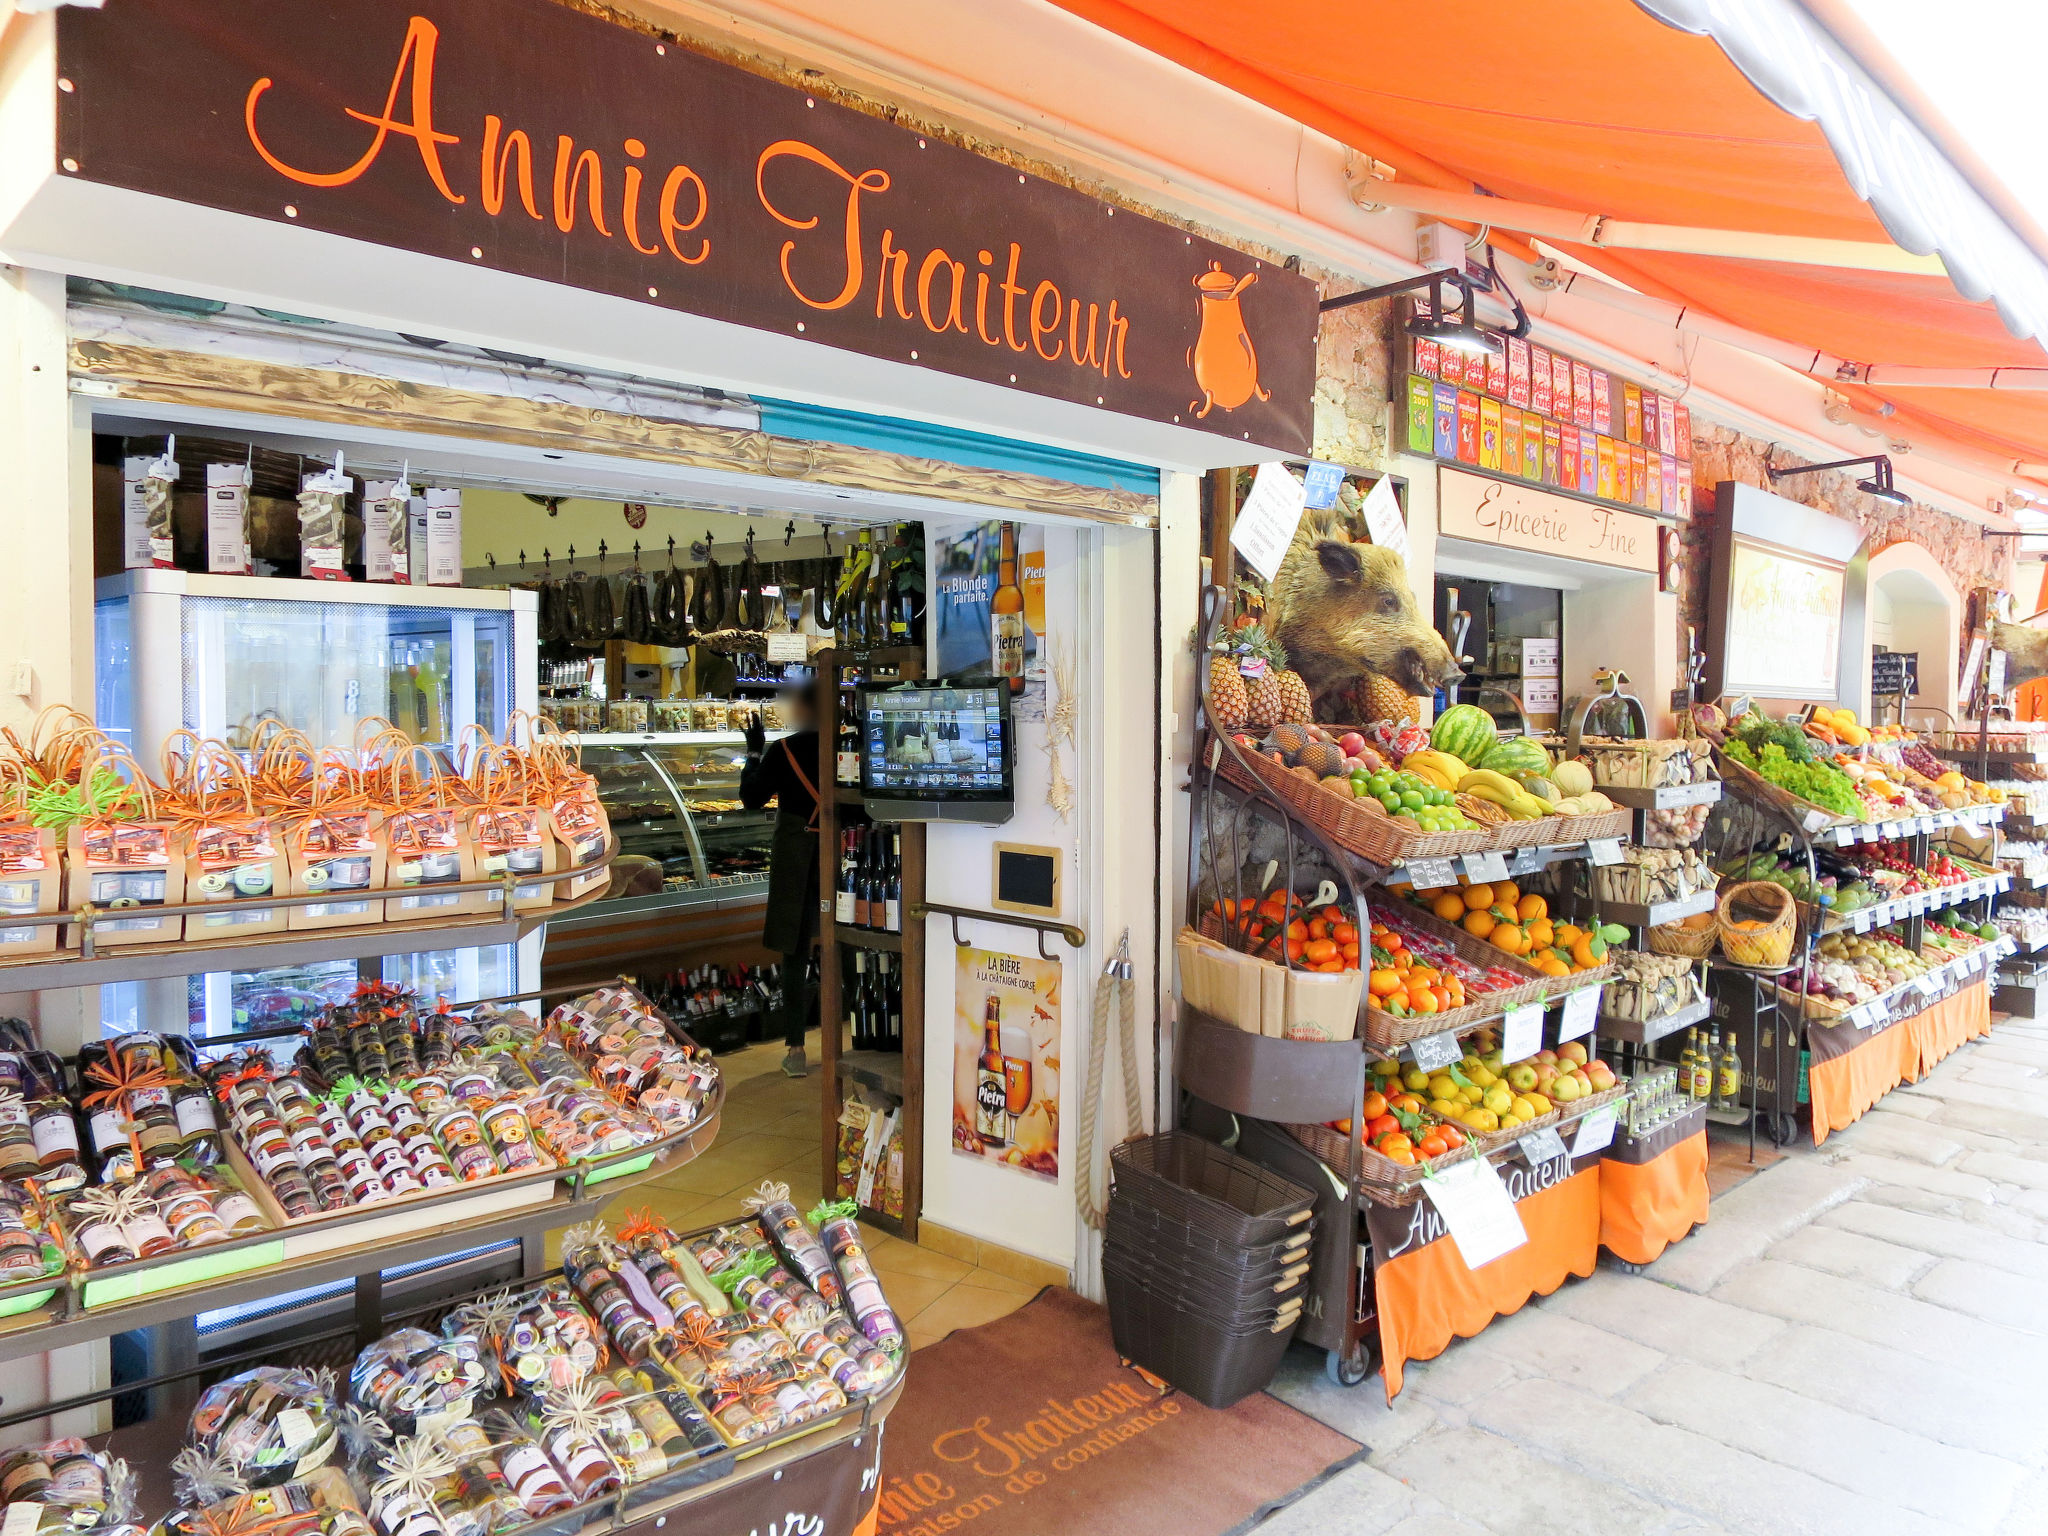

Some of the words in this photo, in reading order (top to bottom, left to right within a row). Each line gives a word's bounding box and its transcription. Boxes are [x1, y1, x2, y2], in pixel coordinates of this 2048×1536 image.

[245, 14, 710, 265] Annie
[756, 139, 1131, 379] Traiteur
[1413, 395, 1429, 407] 2001
[1437, 403, 1455, 414] 2002
[1484, 418, 1499, 428] 2004
[1475, 483, 1568, 542] Epicerie
[1589, 508, 1637, 556] Fine
[942, 584, 951, 594] La
[952, 575, 988, 593] Blonde
[953, 589, 989, 606] parfaite.
[993, 633, 1023, 650] Pietra
[988, 956, 998, 971] LA
[1000, 955, 1021, 974] BIÈRE
[976, 968, 981, 981] À
[981, 973, 988, 982] LA
[989, 971, 1018, 987] CHÂTAIGNE
[1019, 979, 1036, 990] CORSE
[978, 1086, 1006, 1107] Pietra
[1508, 1152, 1575, 1203] aiteur
[932, 1381, 1152, 1477] Traiteur
[908, 1493, 1004, 1536] aison
[1005, 1470, 1047, 1496] de
[1051, 1400, 1184, 1471] confiance
